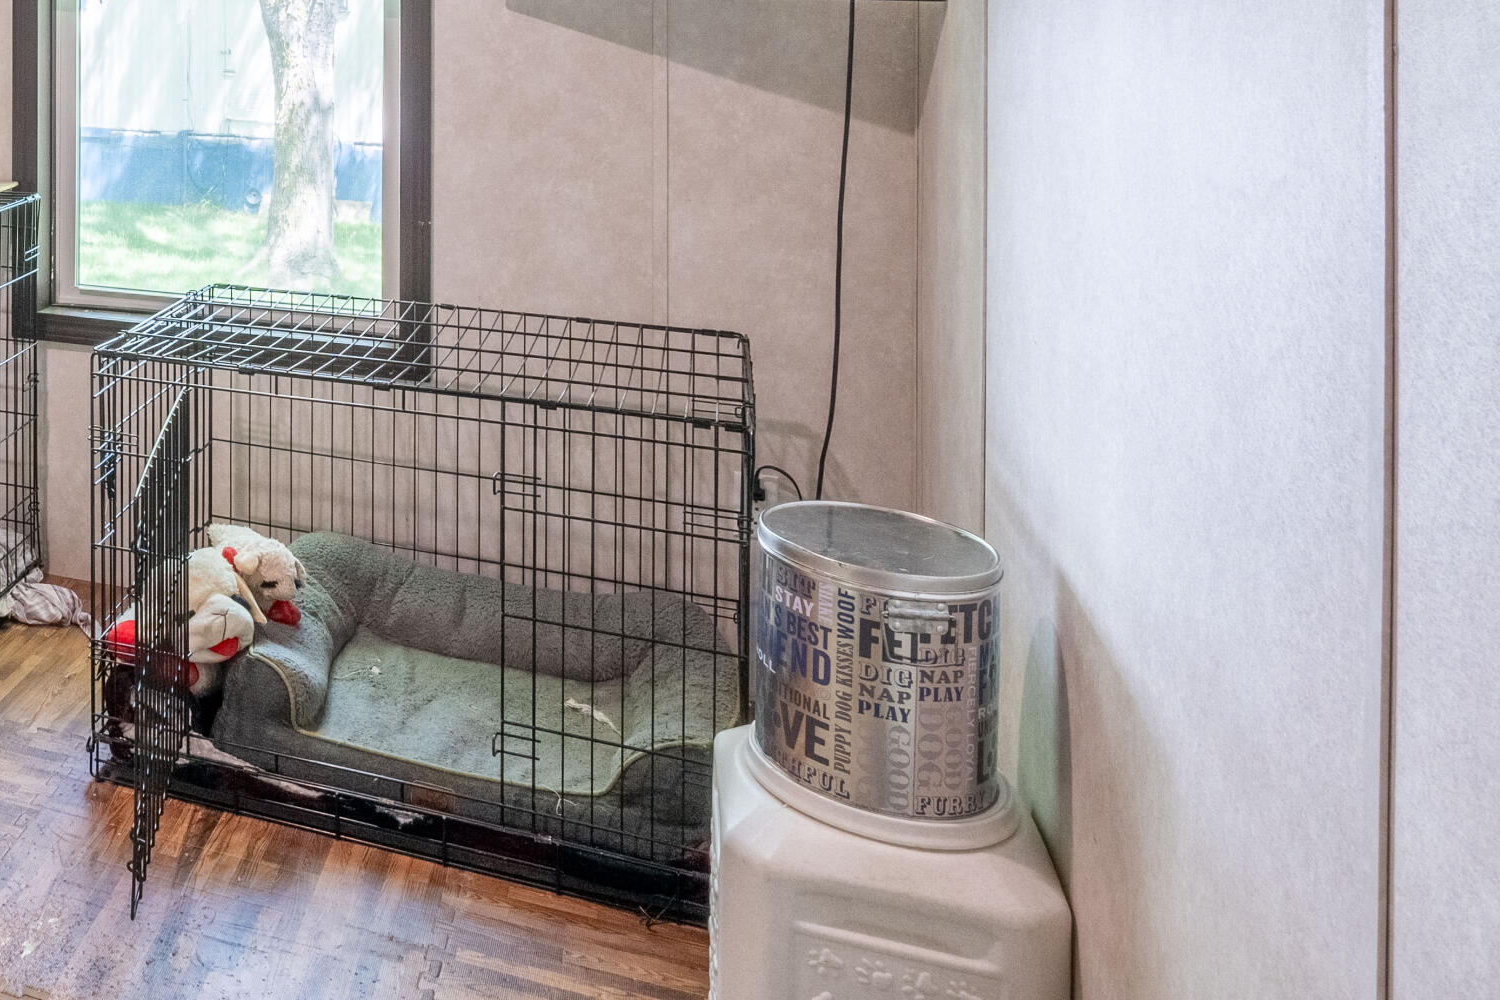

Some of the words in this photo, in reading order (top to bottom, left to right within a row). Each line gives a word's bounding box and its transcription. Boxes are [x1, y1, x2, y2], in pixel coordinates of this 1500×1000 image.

[775, 585, 814, 617] STAY
[837, 587, 856, 640] WOOF
[786, 609, 832, 650] BEST
[756, 643, 776, 674] OLL
[835, 640, 854, 688] KISSES
[920, 648, 966, 666] DIG
[859, 662, 913, 689] DIG
[919, 669, 964, 684] NAP
[966, 647, 977, 727] FIERCELY
[835, 690, 853, 723] DOG
[858, 682, 912, 704] NAP
[918, 686, 964, 703] PLAY
[857, 699, 911, 724] PLAY
[834, 723, 852, 775] PUPPY
[917, 708, 944, 791] DOG
[965, 733, 976, 781] LOYAL
[888, 725, 911, 811] GOOD
